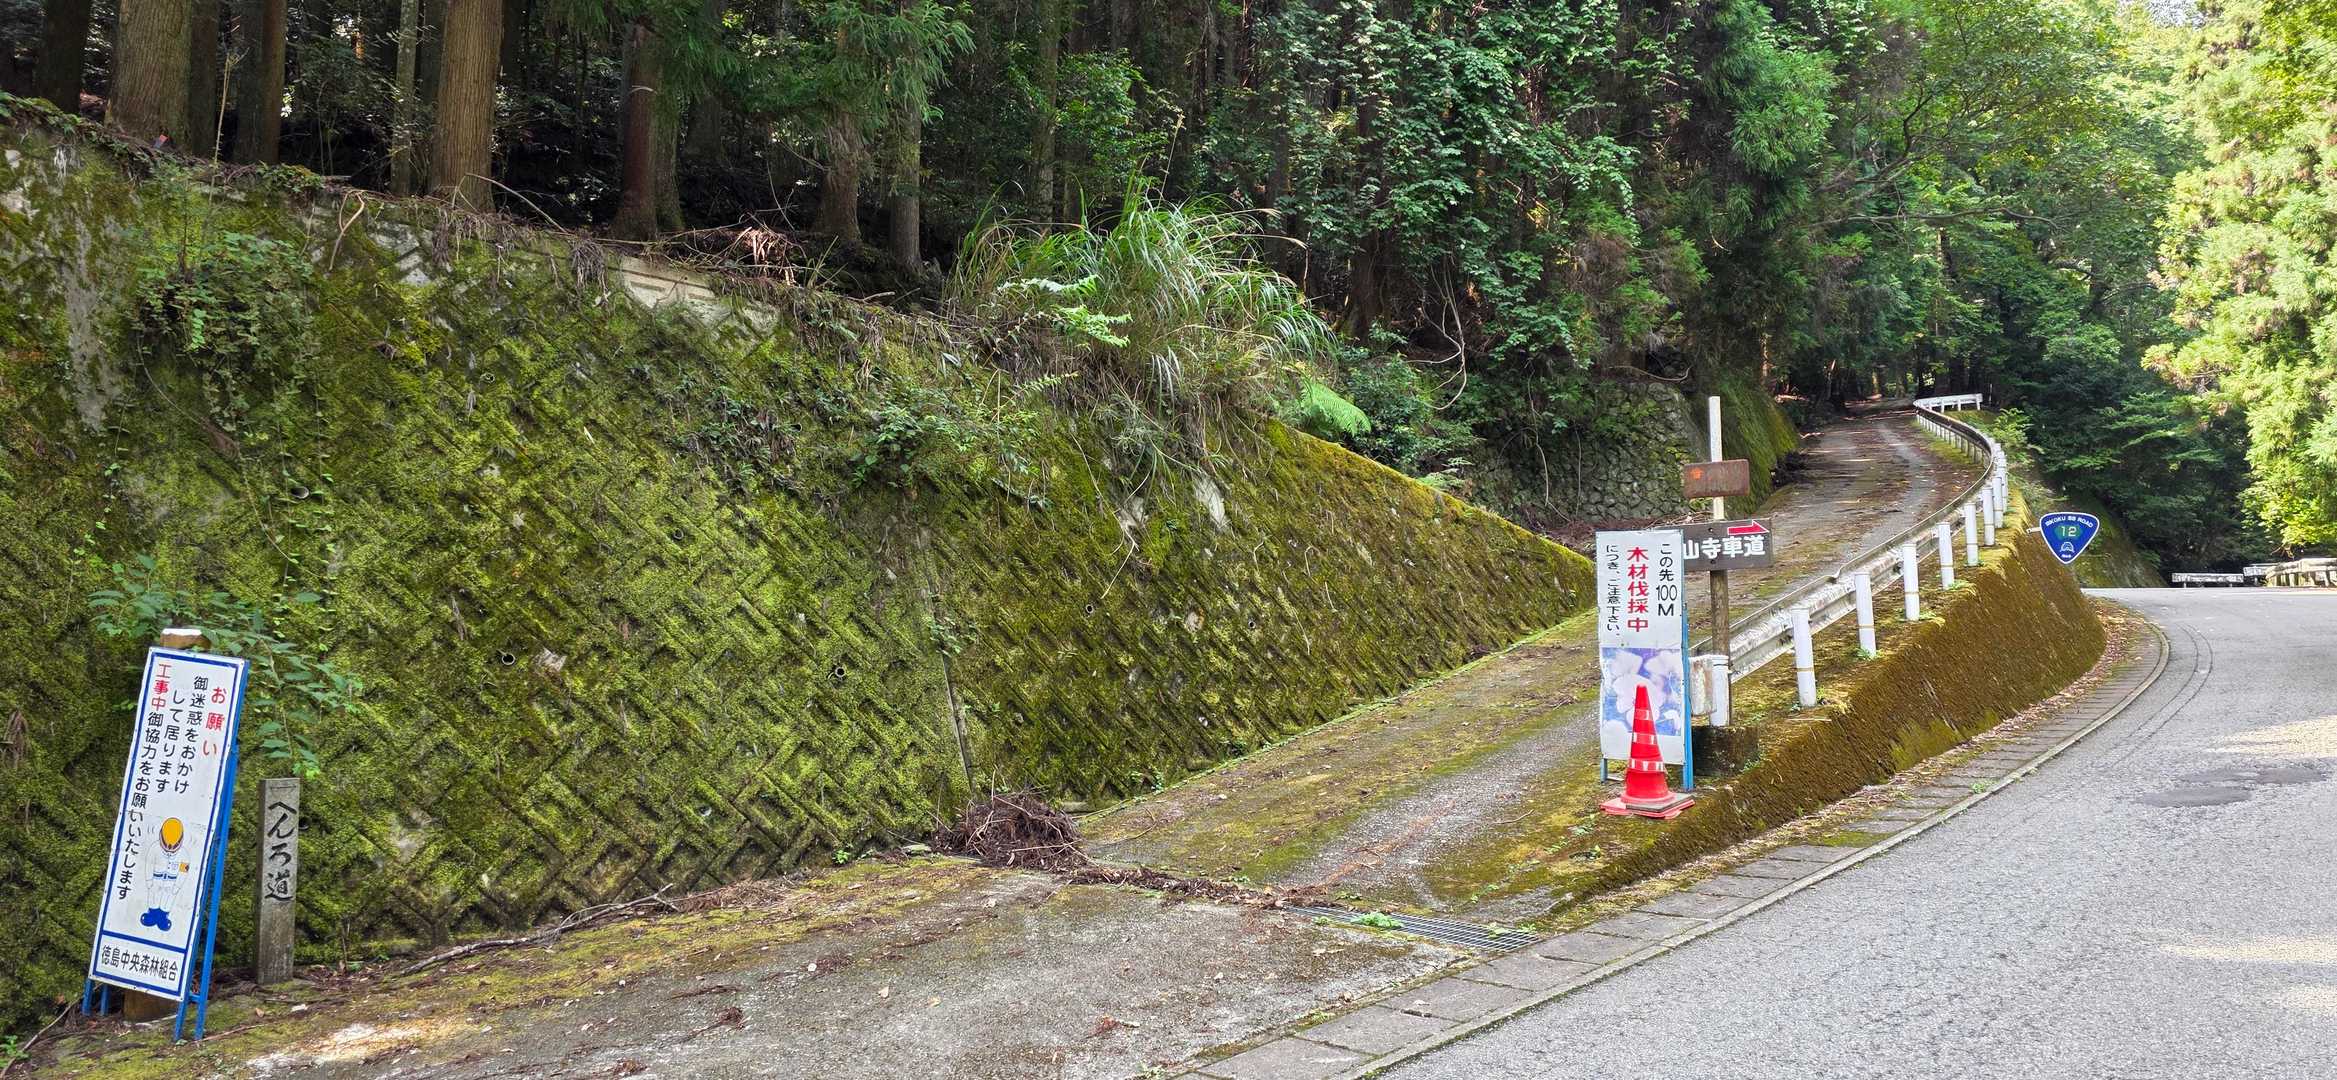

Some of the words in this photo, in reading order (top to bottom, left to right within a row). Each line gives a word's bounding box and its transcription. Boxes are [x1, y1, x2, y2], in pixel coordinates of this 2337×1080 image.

[1682, 535, 1766, 560] 山寺車道
[2061, 526, 2077, 537] 12
[2077, 517, 2094, 528] ROAD
[1627, 546, 1649, 633] 木材伐採中
[1656, 543, 1678, 617] この先100M
[156, 689, 185, 793] して居ります
[174, 675, 208, 794] 御迷惑をおかけ
[202, 686, 227, 756] お願い
[265, 801, 297, 901] へんろ道
[101, 944, 179, 982] 徳島中央森林組合
